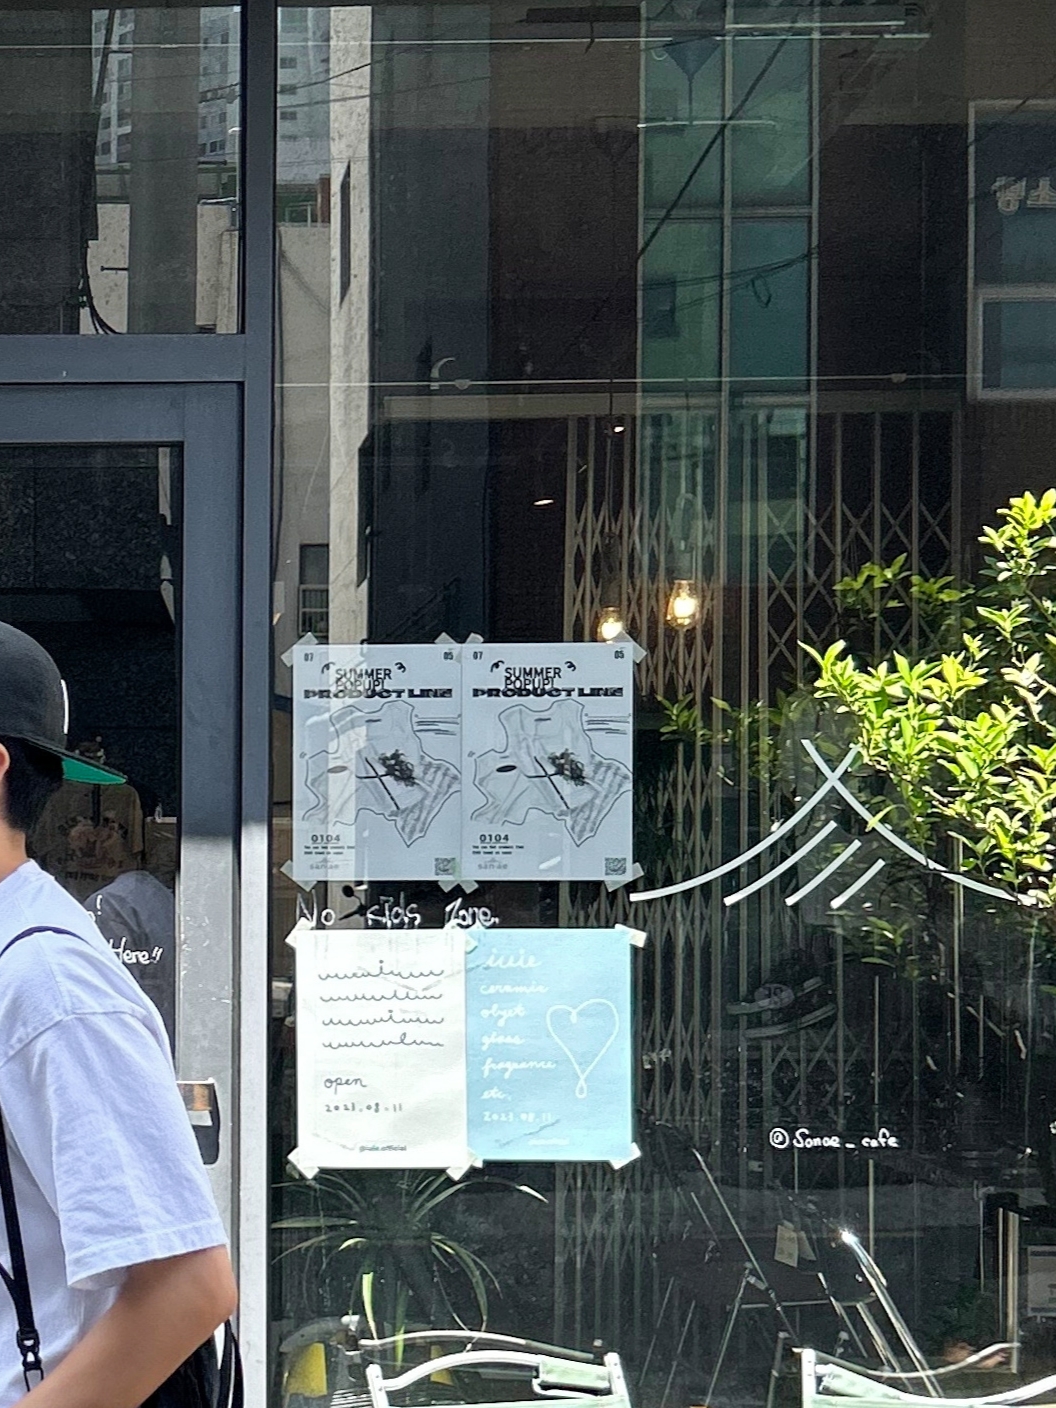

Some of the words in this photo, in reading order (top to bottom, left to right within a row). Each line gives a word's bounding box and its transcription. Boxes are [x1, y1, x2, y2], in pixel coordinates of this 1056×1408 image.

[335, 668, 393, 680] SUMMER
[504, 667, 562, 679] SUMMER
[304, 689, 405, 699] PRODUCT
[472, 687, 575, 698] PRODUCT
[311, 834, 341, 843] 0104
[479, 833, 509, 843] 0104
[323, 1076, 368, 1096] open
